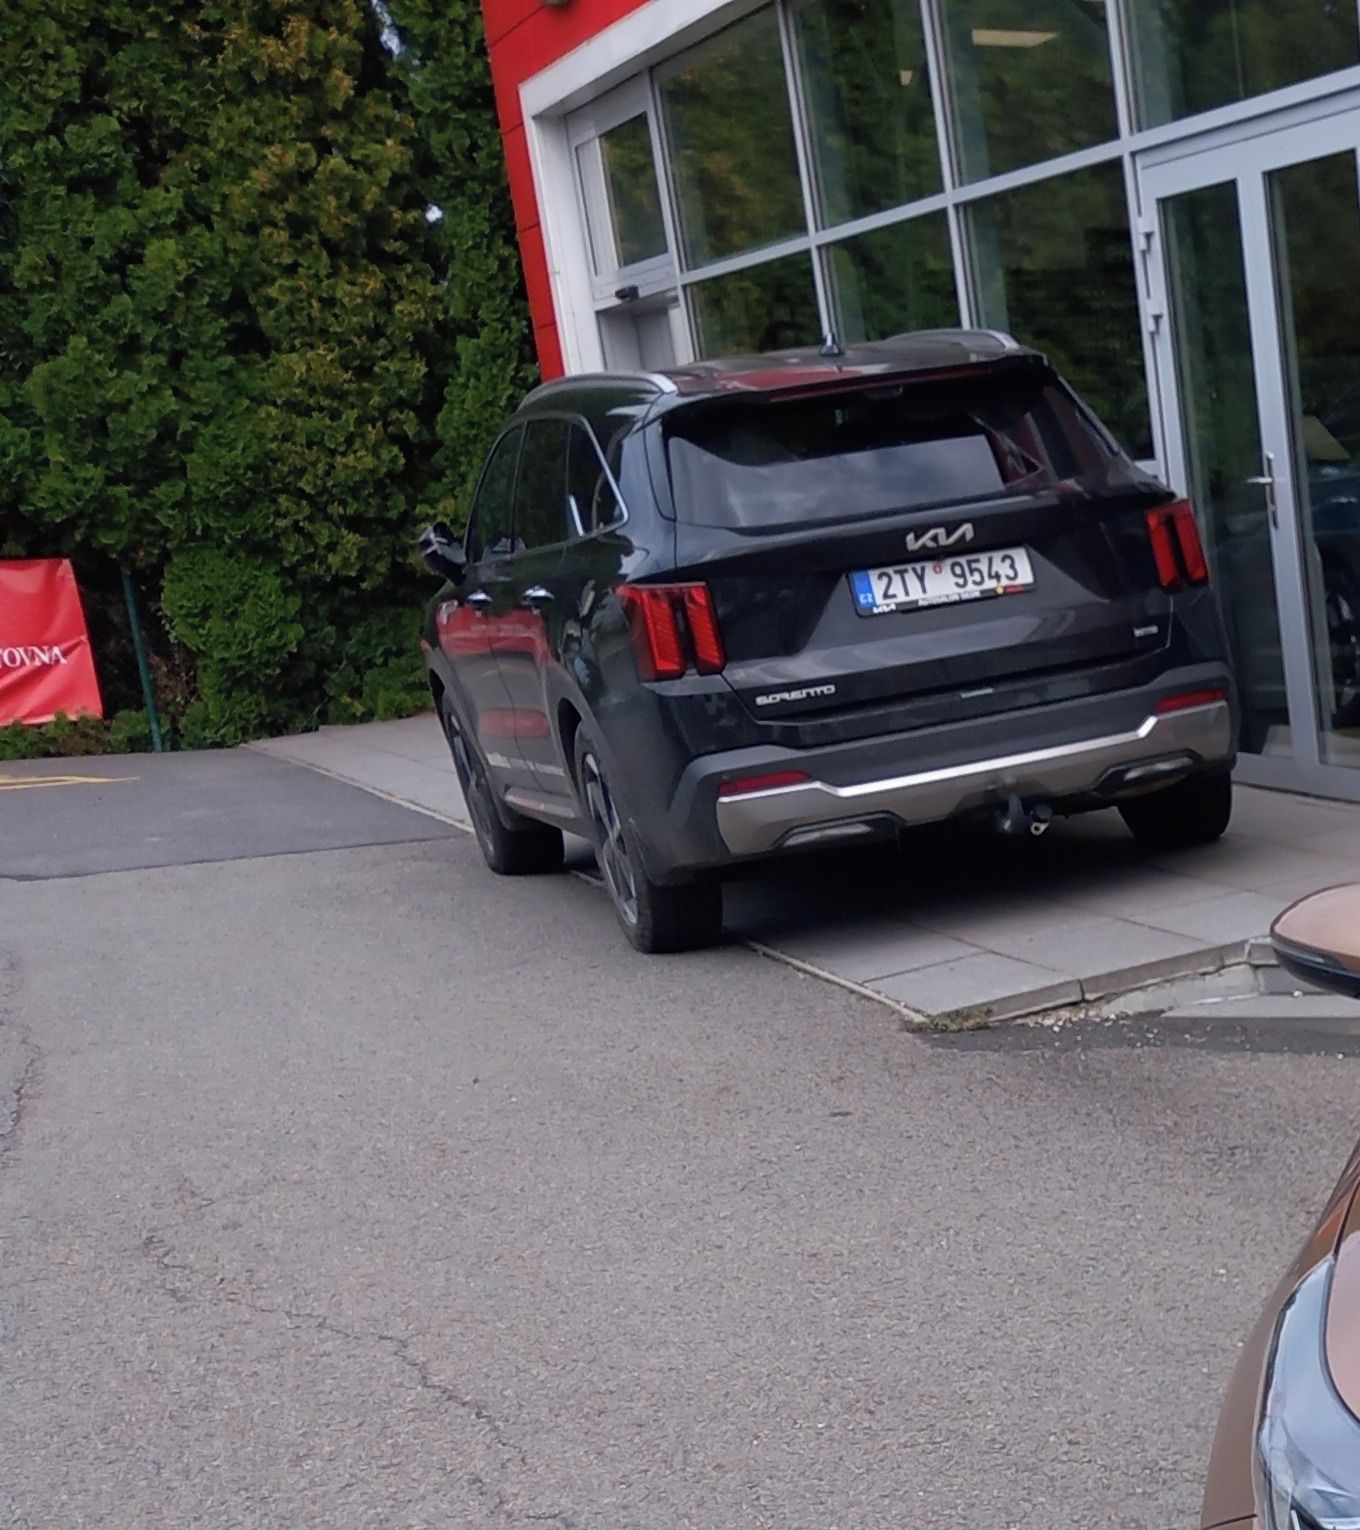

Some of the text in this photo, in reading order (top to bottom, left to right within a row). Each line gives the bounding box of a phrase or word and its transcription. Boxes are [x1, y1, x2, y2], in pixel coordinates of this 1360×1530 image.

[906, 522, 974, 551] KIA
[877, 565, 928, 601] 2TY
[951, 554, 1019, 589] 9543
[755, 684, 836, 706] SORENTO
